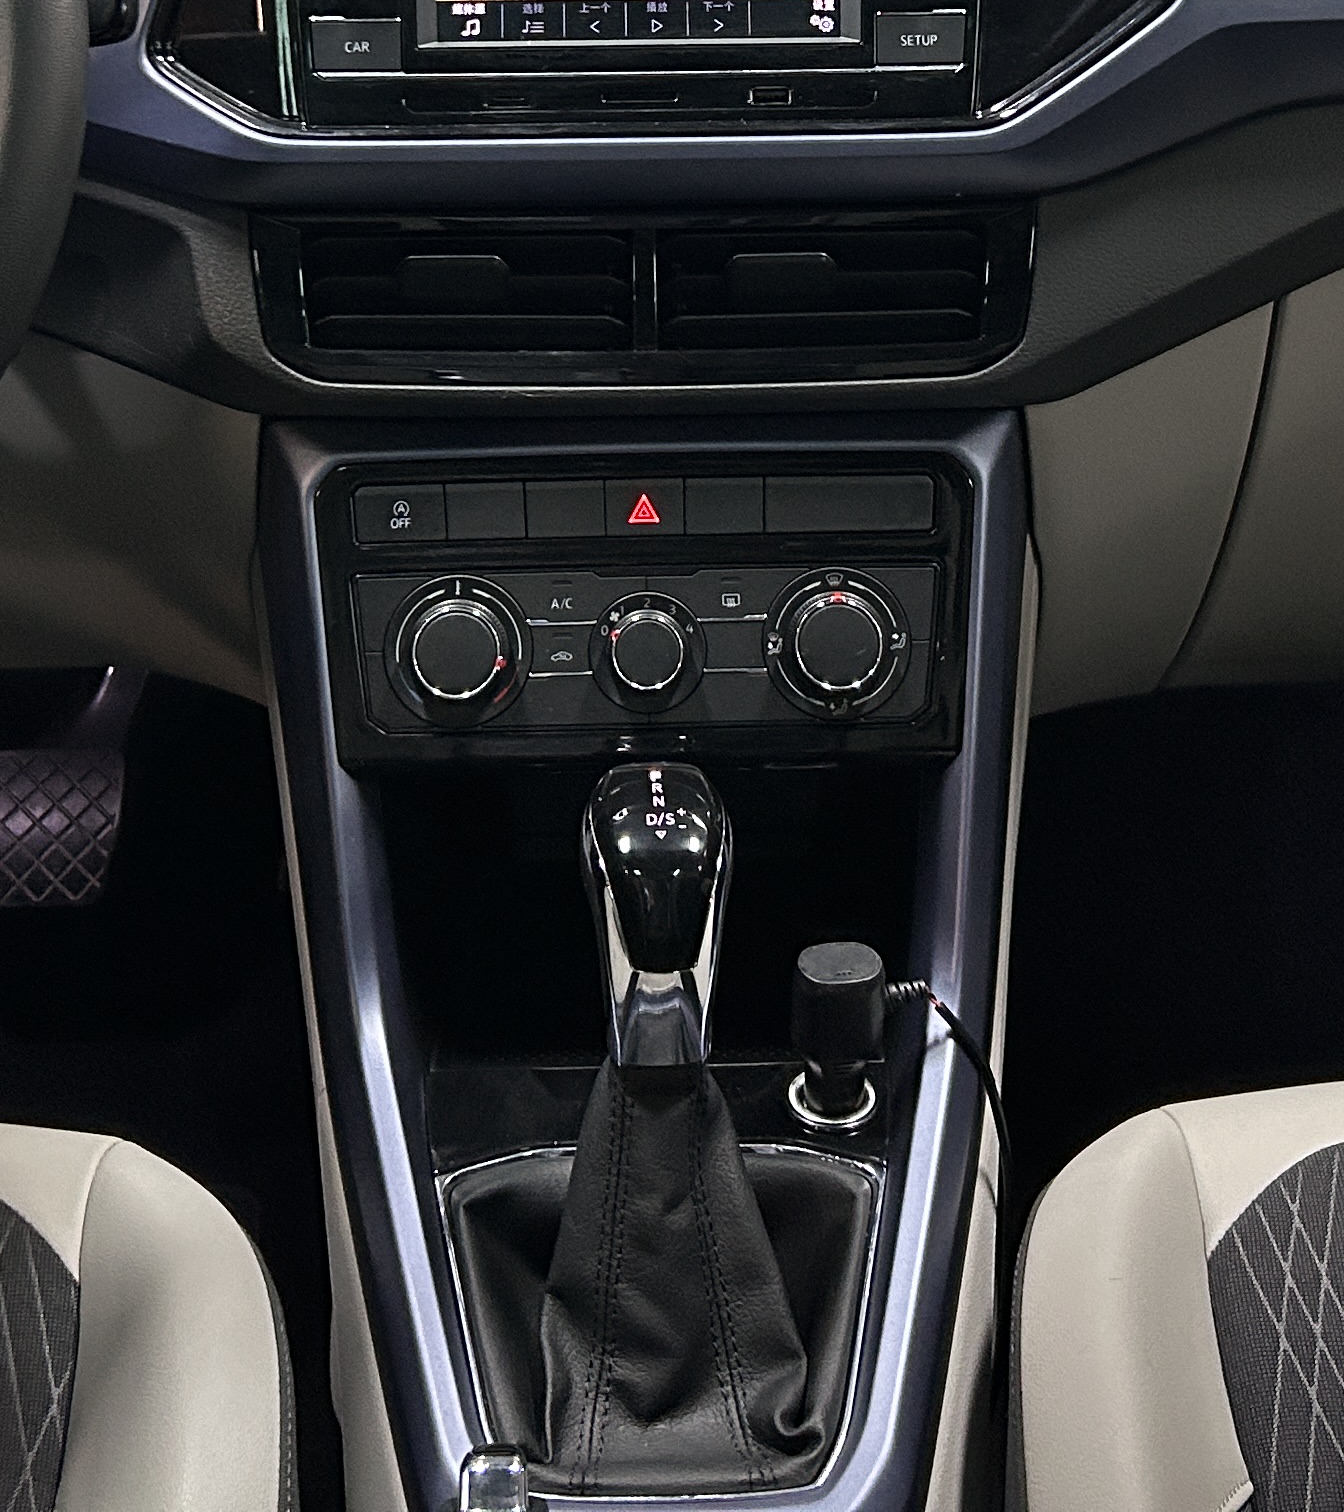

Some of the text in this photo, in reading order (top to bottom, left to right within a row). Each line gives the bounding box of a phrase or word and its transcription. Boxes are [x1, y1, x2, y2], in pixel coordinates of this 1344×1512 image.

[578, 2, 612, 14] 上一个
[703, 0, 735, 12] 下一个
[900, 34, 938, 47] SETUP
[344, 41, 370, 54] CAR
[390, 517, 412, 530] OFF
[550, 597, 574, 610] A/C
[643, 597, 652, 608] 2
[668, 604, 677, 615] 3
[685, 623, 694, 634] 4
[651, 782, 663, 794] R
[652, 795, 665, 807] N
[645, 812, 675, 827] D/S
